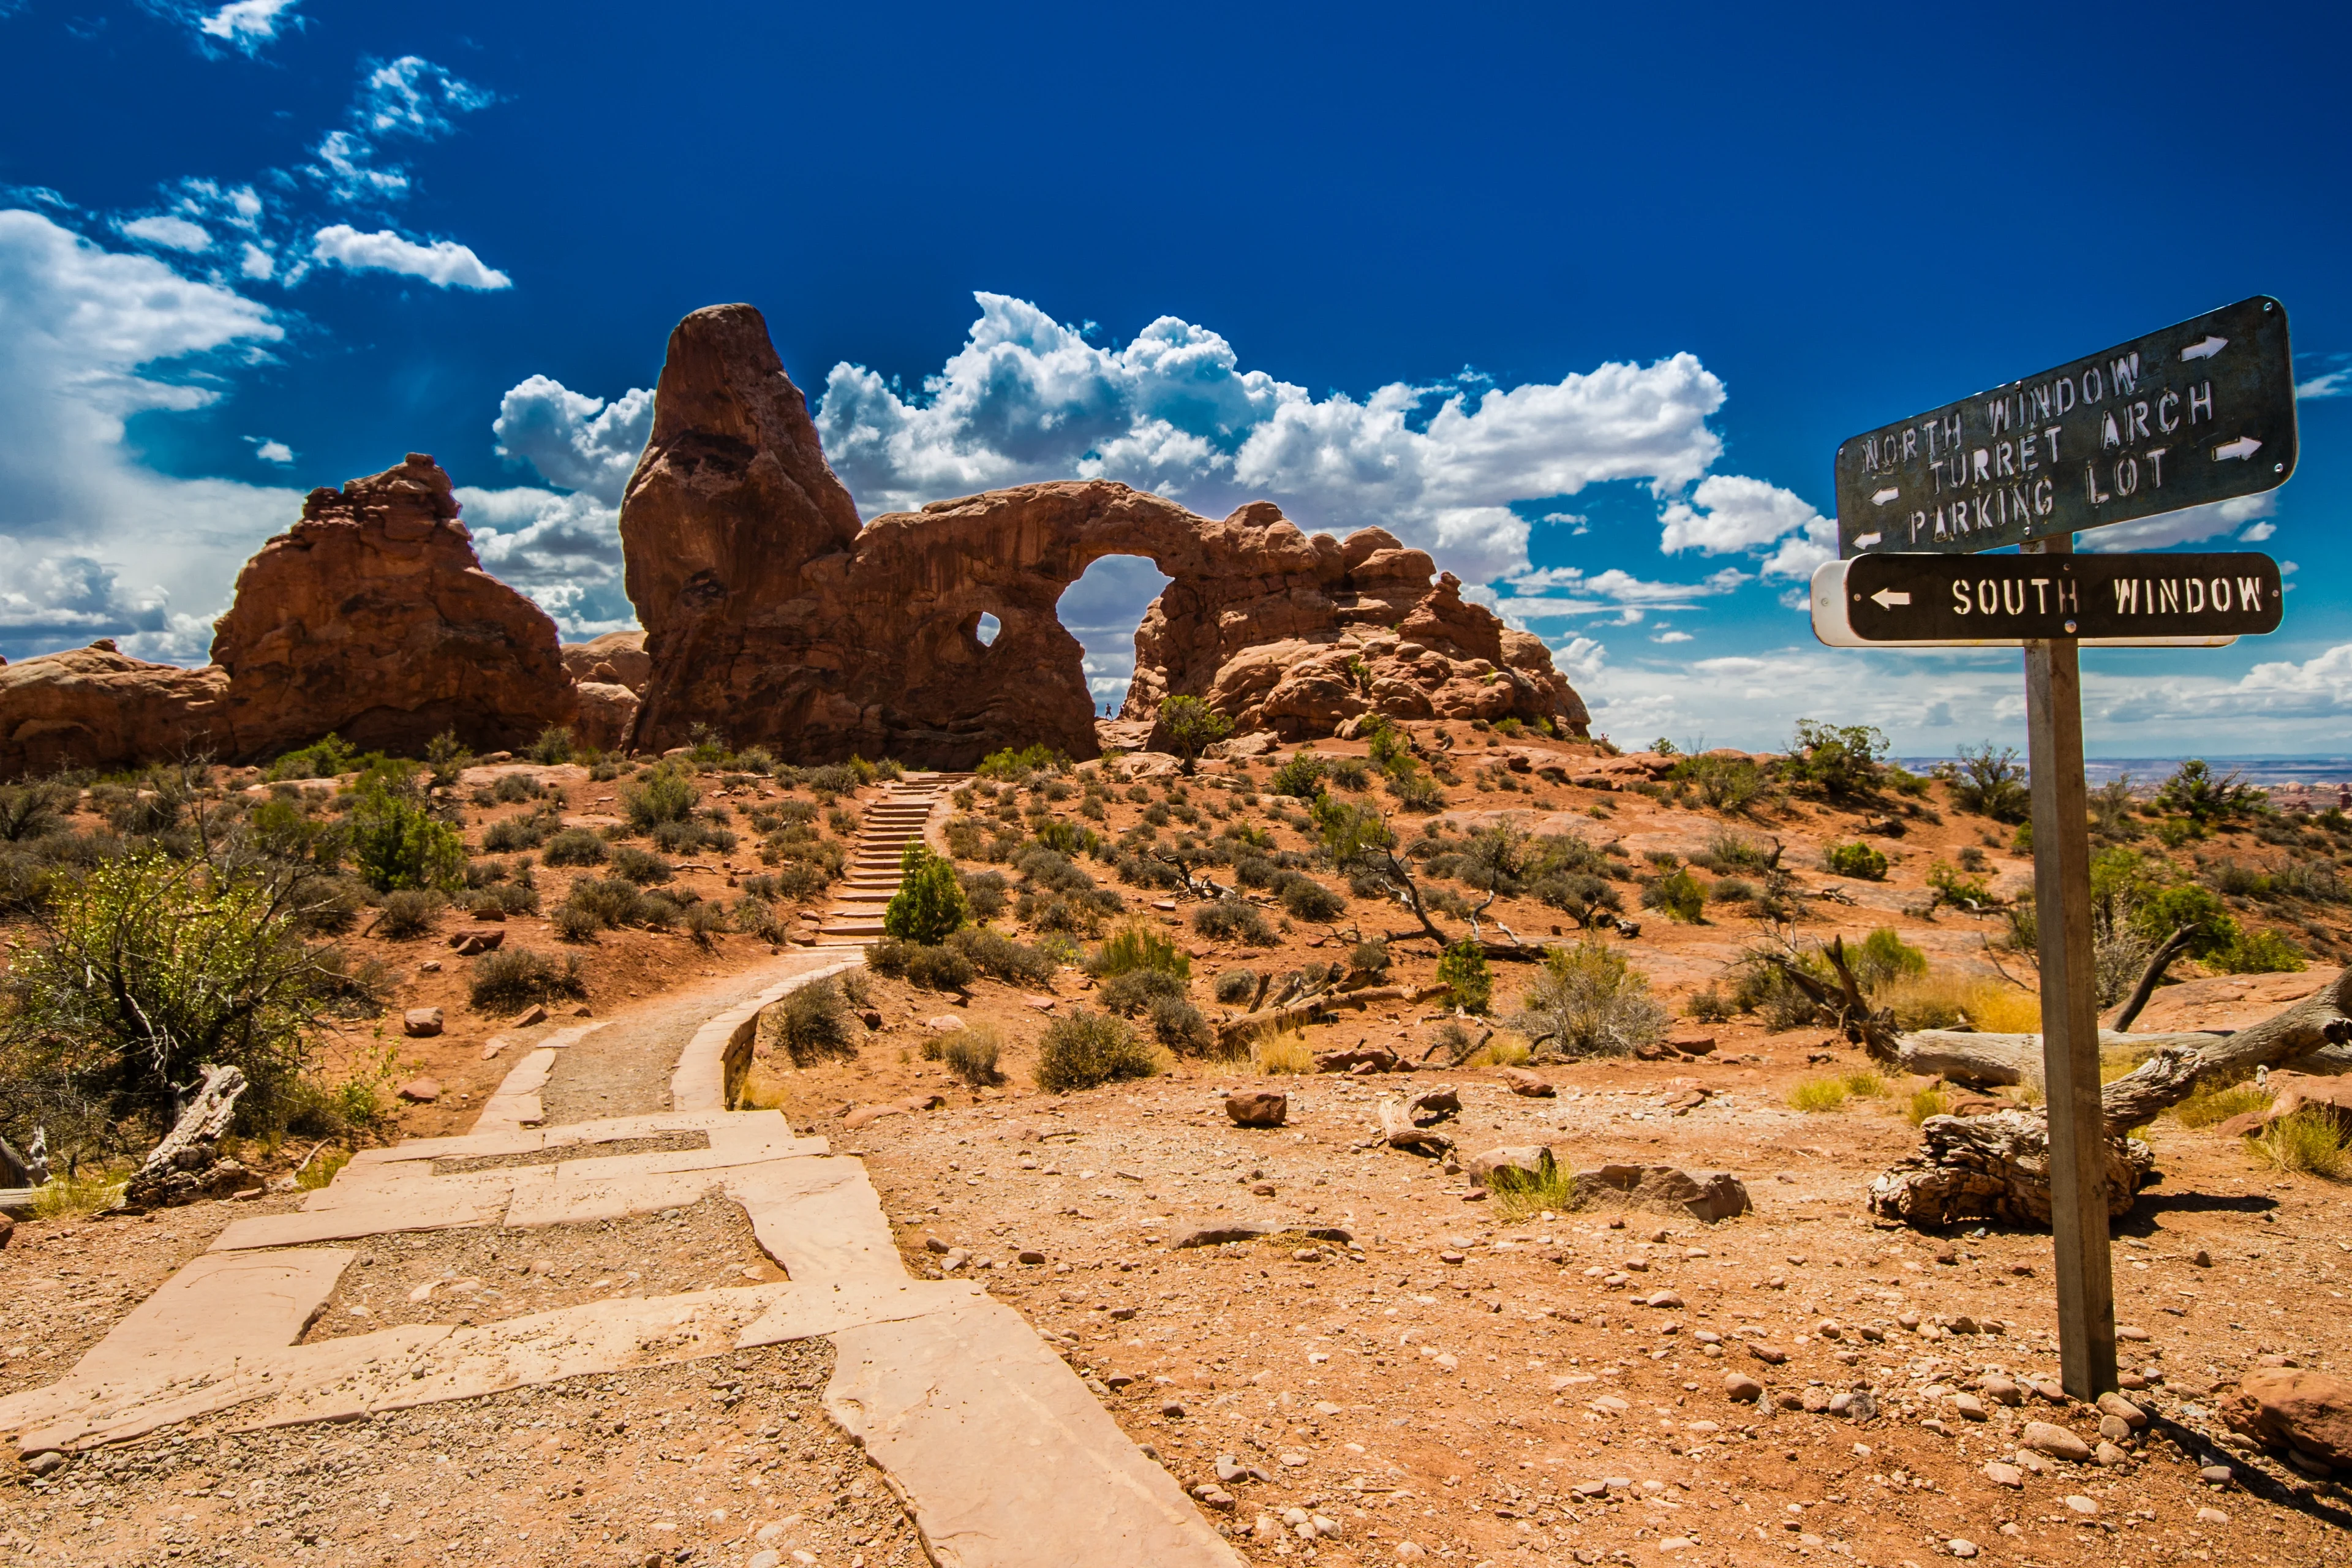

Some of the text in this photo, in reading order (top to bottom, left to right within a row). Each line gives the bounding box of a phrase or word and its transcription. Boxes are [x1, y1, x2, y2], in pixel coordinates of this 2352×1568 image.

[1862, 352, 2139, 473] NORTH WINDOW
[1929, 380, 2213, 494] TURRET ARCH
[1909, 449, 2166, 544] PARKING LOT
[1953, 577, 2263, 615] SOUTH WINDOW
